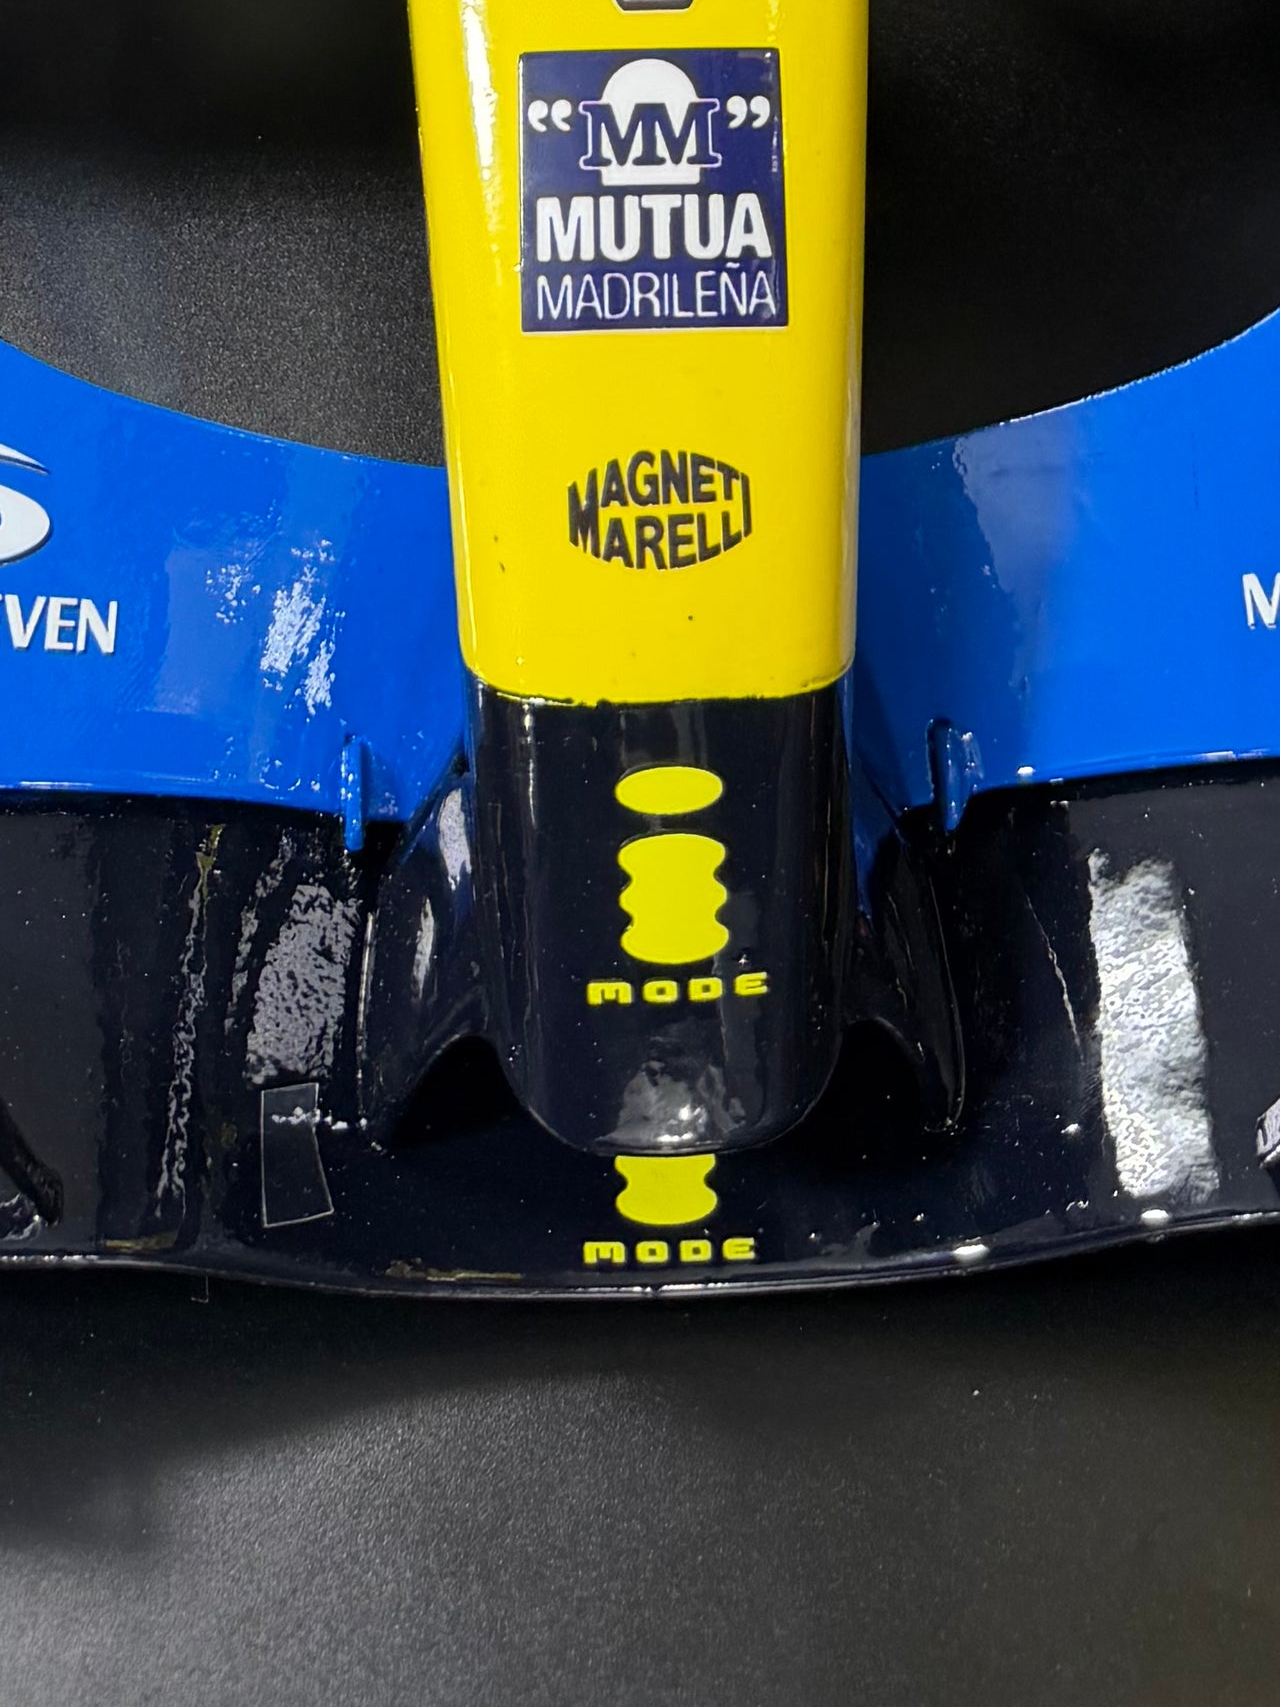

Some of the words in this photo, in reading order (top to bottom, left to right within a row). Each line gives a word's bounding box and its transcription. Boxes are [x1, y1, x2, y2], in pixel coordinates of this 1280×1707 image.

[536, 192, 773, 263] MUTUA
[536, 262, 778, 321] MADRILEÑA
[567, 449, 753, 534] MAGNETI
[567, 492, 753, 572] MARELLI
